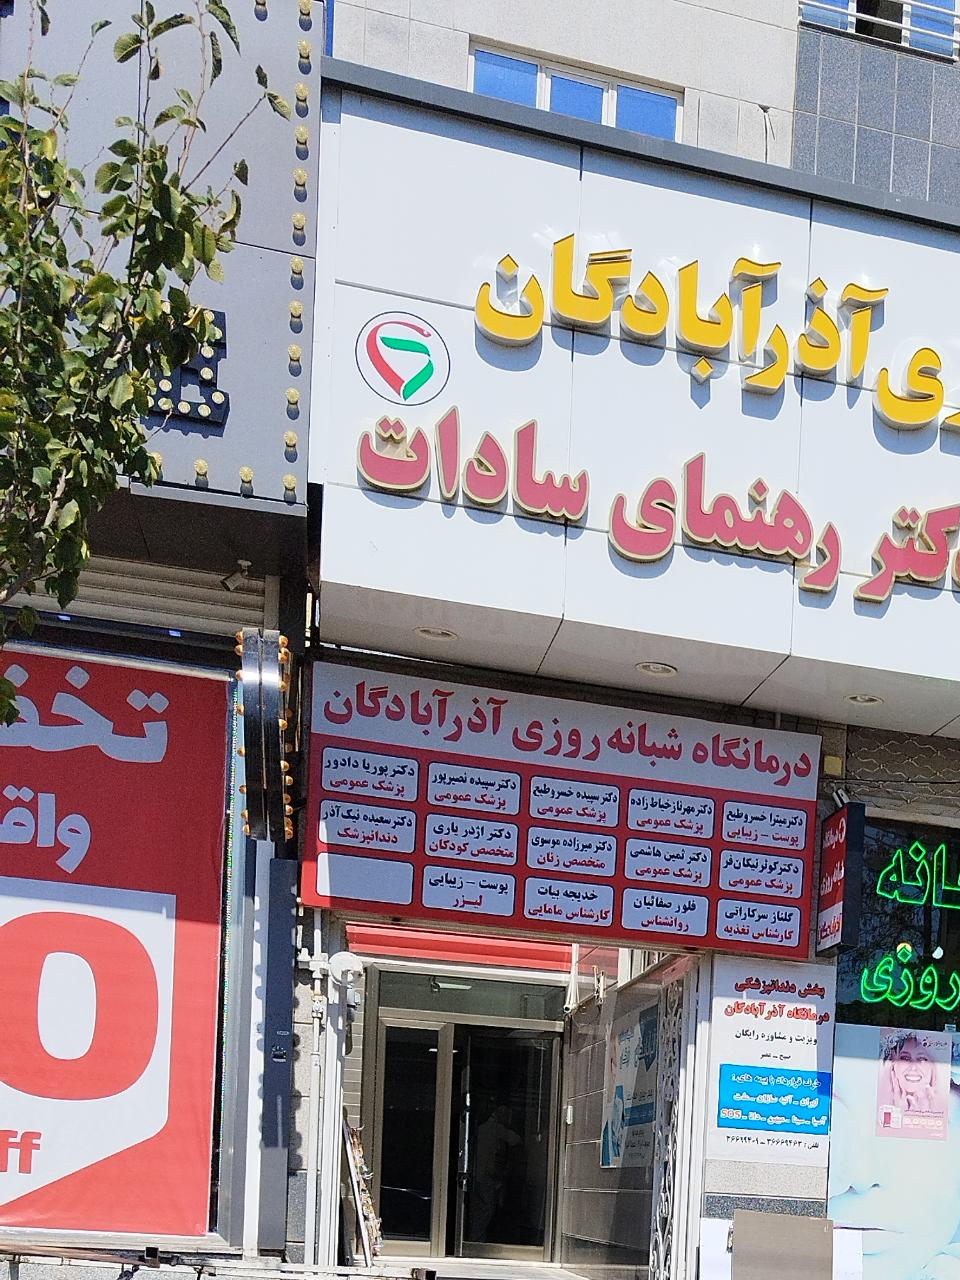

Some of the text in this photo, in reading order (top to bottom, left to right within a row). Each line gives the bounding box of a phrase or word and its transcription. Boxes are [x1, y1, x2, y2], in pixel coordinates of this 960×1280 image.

[358, 405, 590, 525] سادات
[608, 452, 841, 593] رهنمای
[512, 717, 600, 762] روزی
[607, 721, 682, 768] شبانه
[324, 756, 415, 778] دکتر پوریا دادور
[692, 734, 812, 787] درمانگاه
[330, 779, 405, 797] پزشک عمومی
[470, 776, 496, 791] سپیده
[495, 778, 517, 792] دکتر
[434, 791, 506, 810] پزشک عمومی
[576, 789, 600, 804] سپیده
[600, 791, 618, 805] دکتر
[537, 805, 607, 823] پزشک عمومی
[695, 804, 712, 816] دکتر
[363, 813, 391, 826] سعیده
[391, 815, 412, 829] دکتر
[636, 817, 704, 834] پزشک عمومی
[769, 812, 789, 827] میترا
[788, 816, 803, 829] دکتر
[337, 827, 398, 844] دندانپزشک
[433, 821, 511, 841] دکتر اژدر یاری
[727, 826, 799, 847] پوست زیبایی
[429, 839, 514, 858] متخصص کودکان
[531, 834, 561, 849] موسوی
[594, 839, 612, 854] دکتر
[630, 845, 661, 858] هاشمی
[687, 851, 708, 864] دکتر
[537, 853, 605, 869] متخصص زنان
[759, 858, 778, 873] کوثر
[778, 863, 799, 876] دکتر
[635, 866, 702, 884] پزشک عمومی
[429, 873, 508, 895] پوست زیبایی
[728, 877, 793, 894] پزشک عمومی
[538, 884, 598, 903] خدیجه بیات
[528, 903, 610, 923] کارشناس مامایی
[675, 900, 697, 914] فلور
[641, 915, 689, 932] روانشناس
[771, 910, 793, 924] گلناز
[724, 923, 793, 943] کارشناس تغذیه
